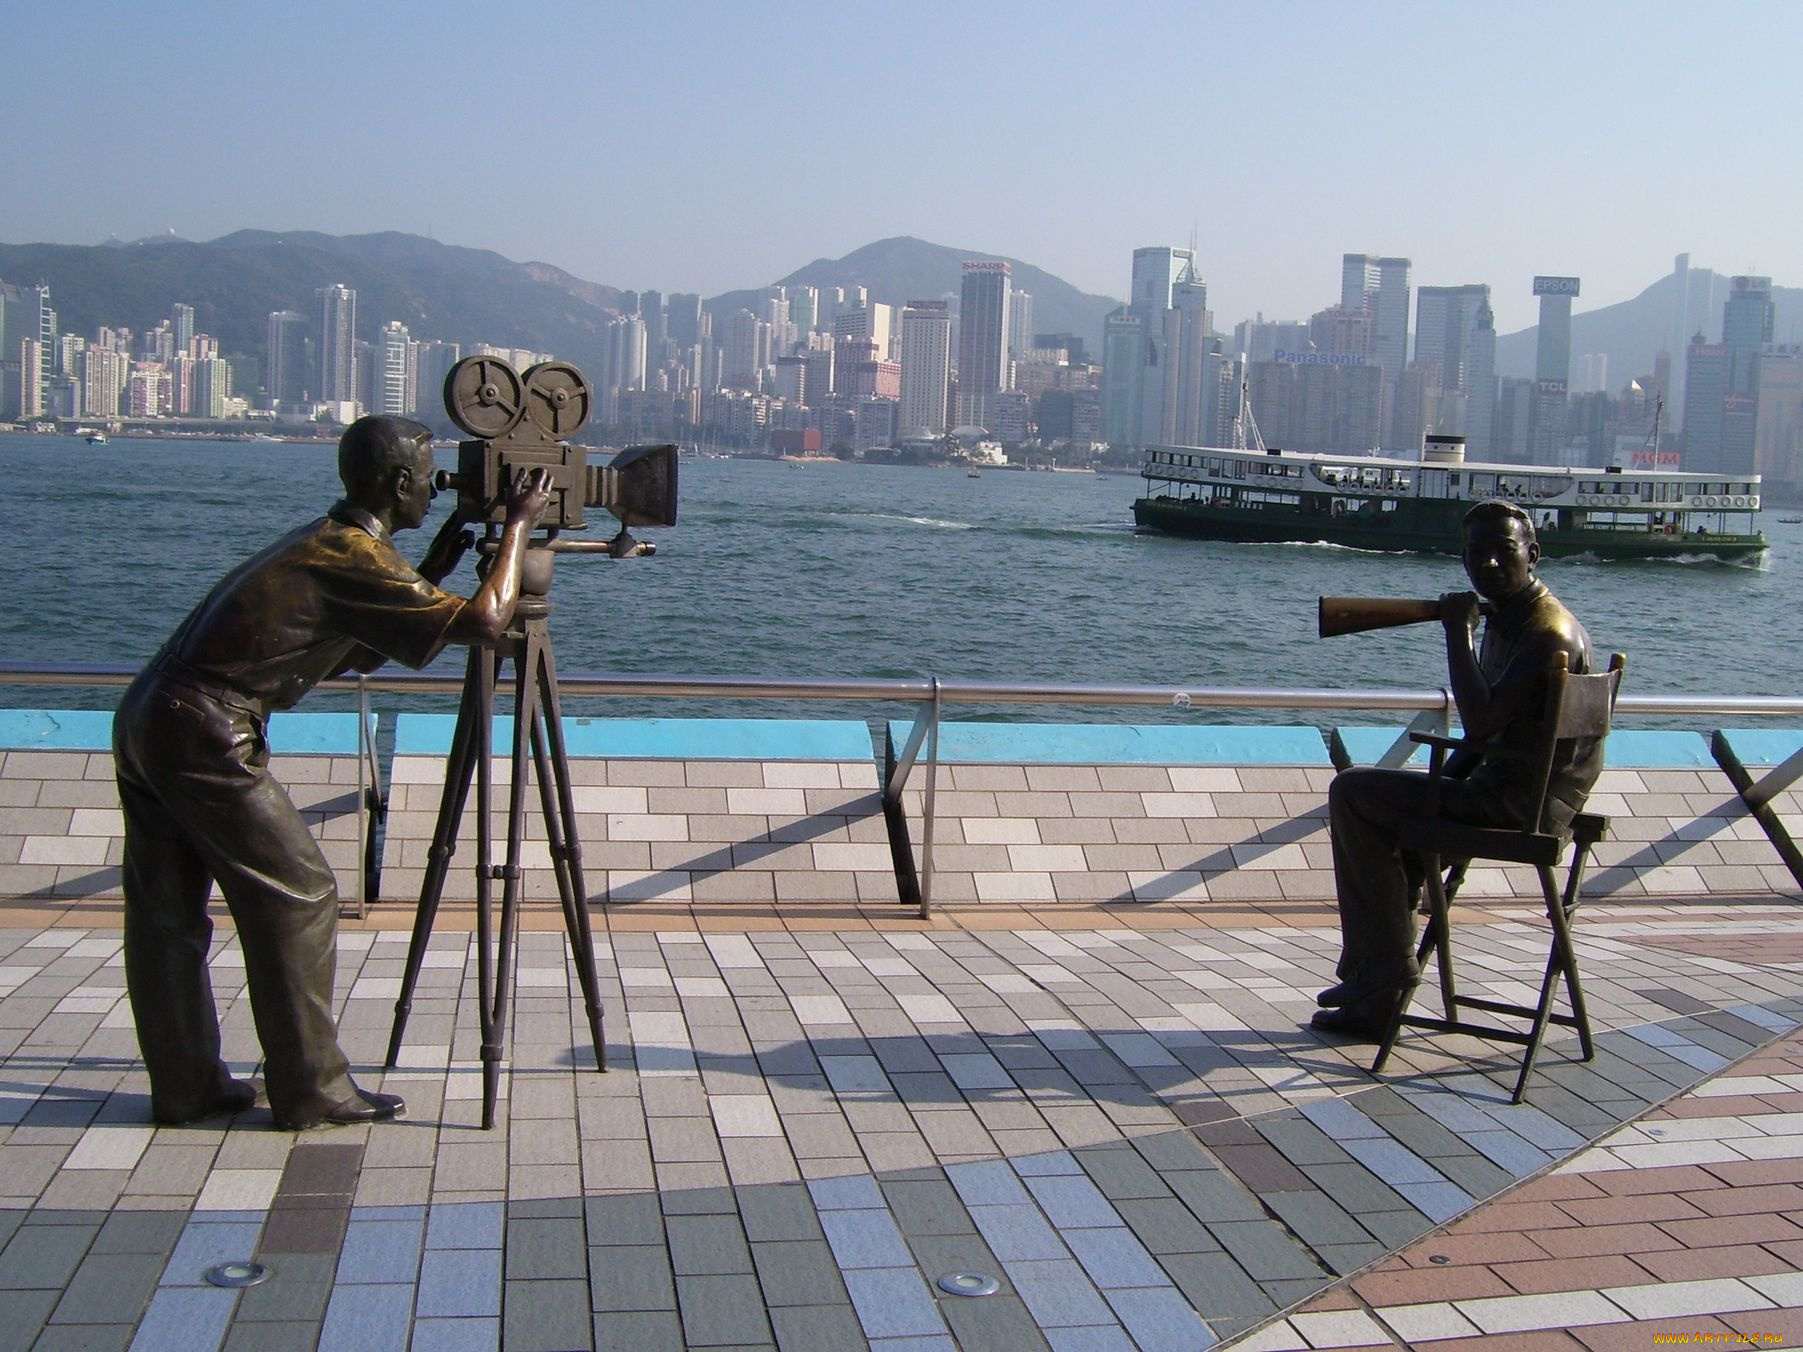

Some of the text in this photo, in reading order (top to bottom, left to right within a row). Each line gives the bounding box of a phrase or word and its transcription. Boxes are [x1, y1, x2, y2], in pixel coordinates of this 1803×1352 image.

[962, 261, 1005, 270] SHARP
[1535, 280, 1578, 291] EPSON
[1274, 349, 1367, 364] Panasonic
[1540, 382, 1567, 391] TCL
[1632, 452, 1678, 465] MGM
